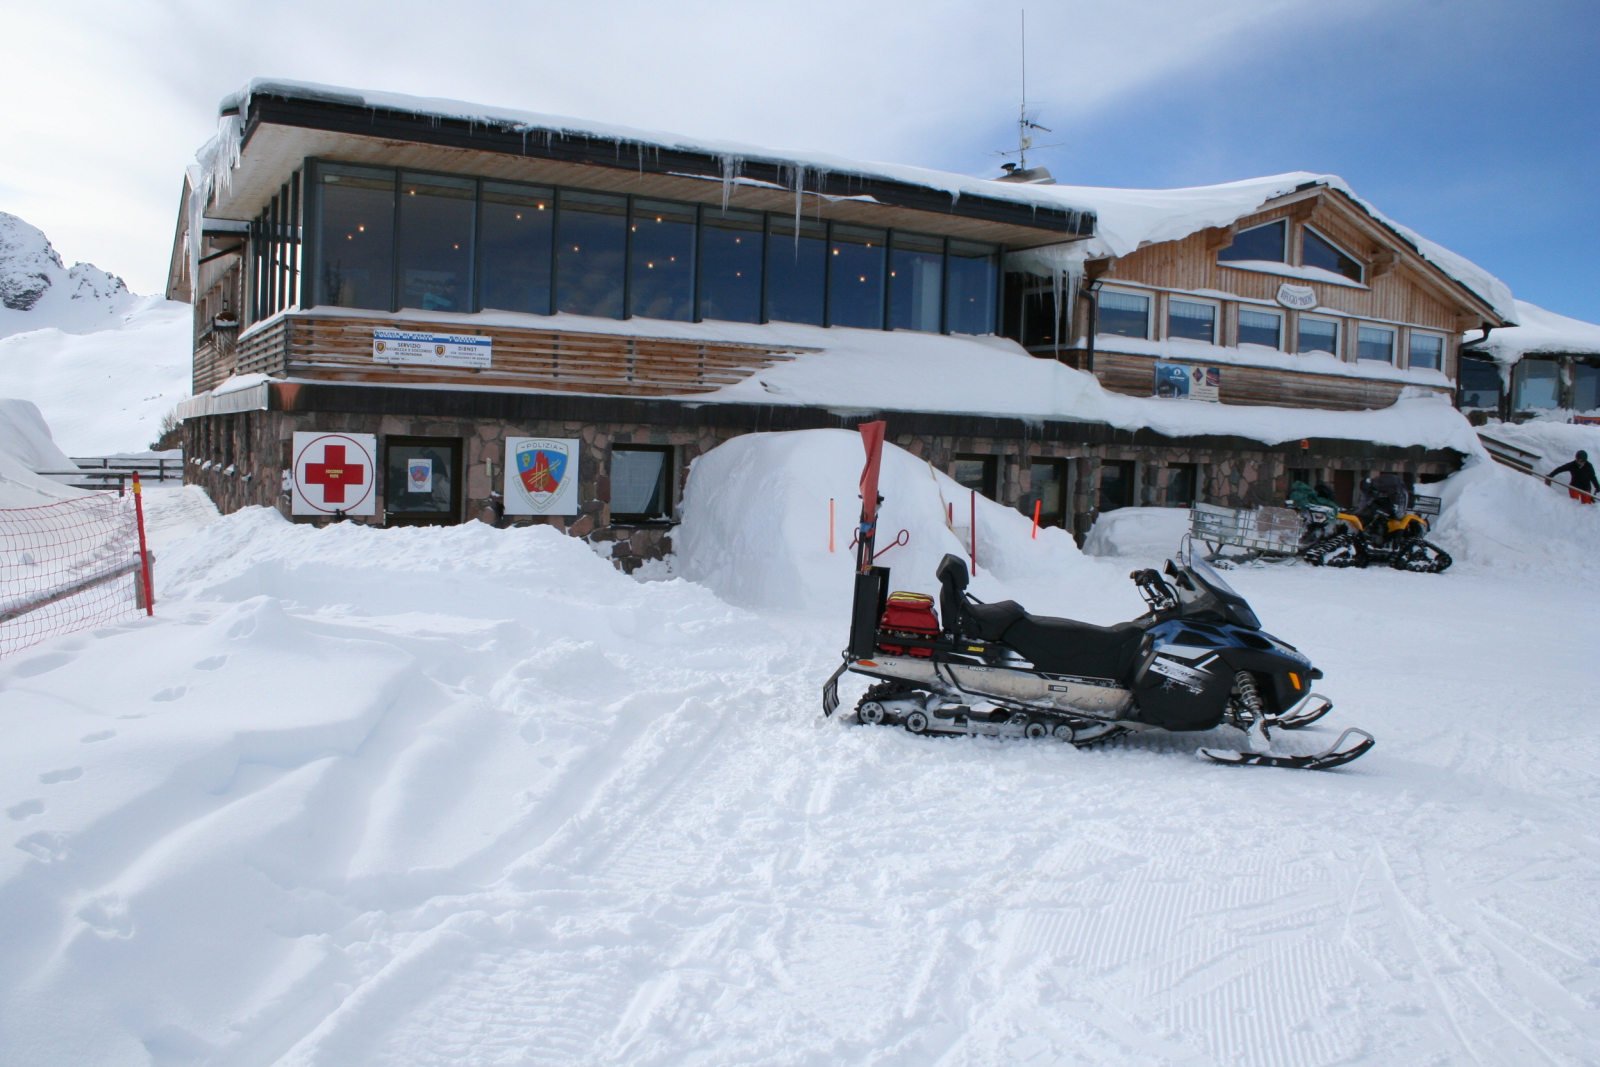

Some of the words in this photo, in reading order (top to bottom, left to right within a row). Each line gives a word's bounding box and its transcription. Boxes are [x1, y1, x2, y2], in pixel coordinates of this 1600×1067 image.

[374, 330, 400, 339] POLIZIA
[412, 333, 434, 341] STATO
[526, 442, 558, 450] POLIZIA
